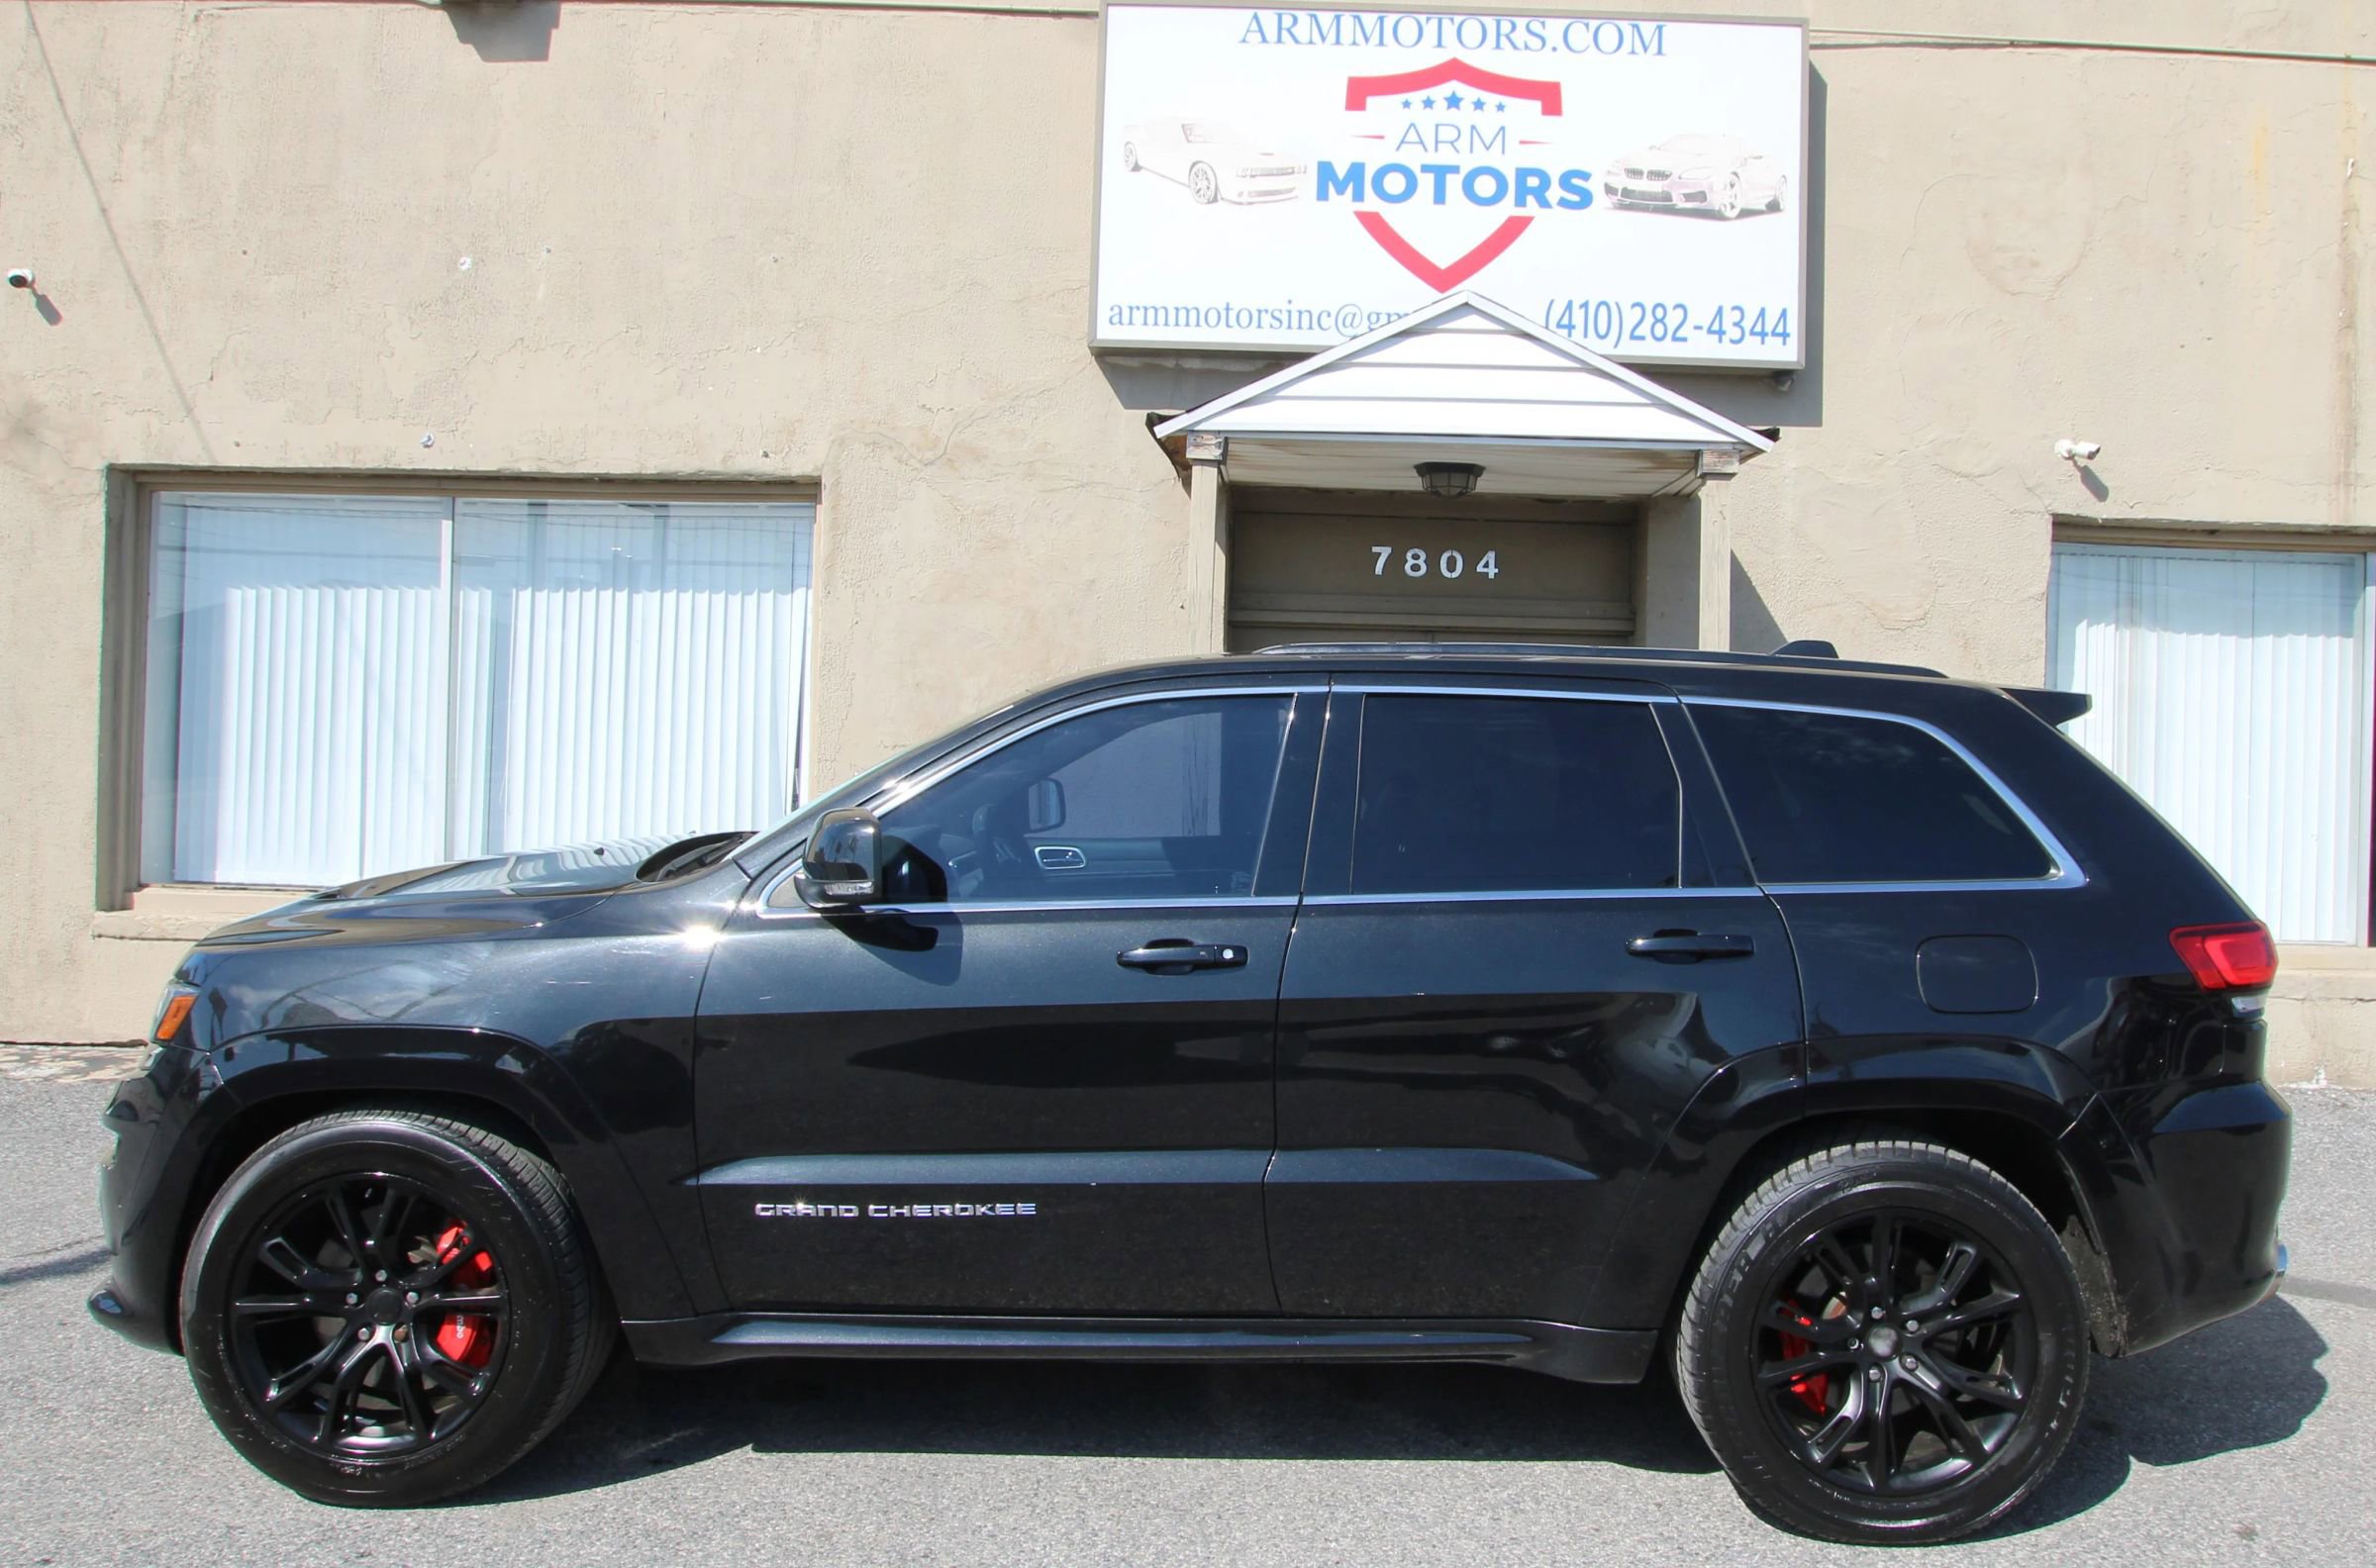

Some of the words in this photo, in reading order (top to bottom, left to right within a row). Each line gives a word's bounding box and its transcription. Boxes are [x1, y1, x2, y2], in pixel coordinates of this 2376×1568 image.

[1238, 11, 1667, 56] ARMMOTORS.COM
[1395, 122, 1507, 155] ARM
[1316, 160, 1594, 211] MOTORS
[1544, 298, 1791, 348] (410)282-4344
[1371, 545, 1499, 579] 7804
[754, 1203, 859, 1218] GRAND
[868, 1202, 1037, 1218] CHEROKEE
